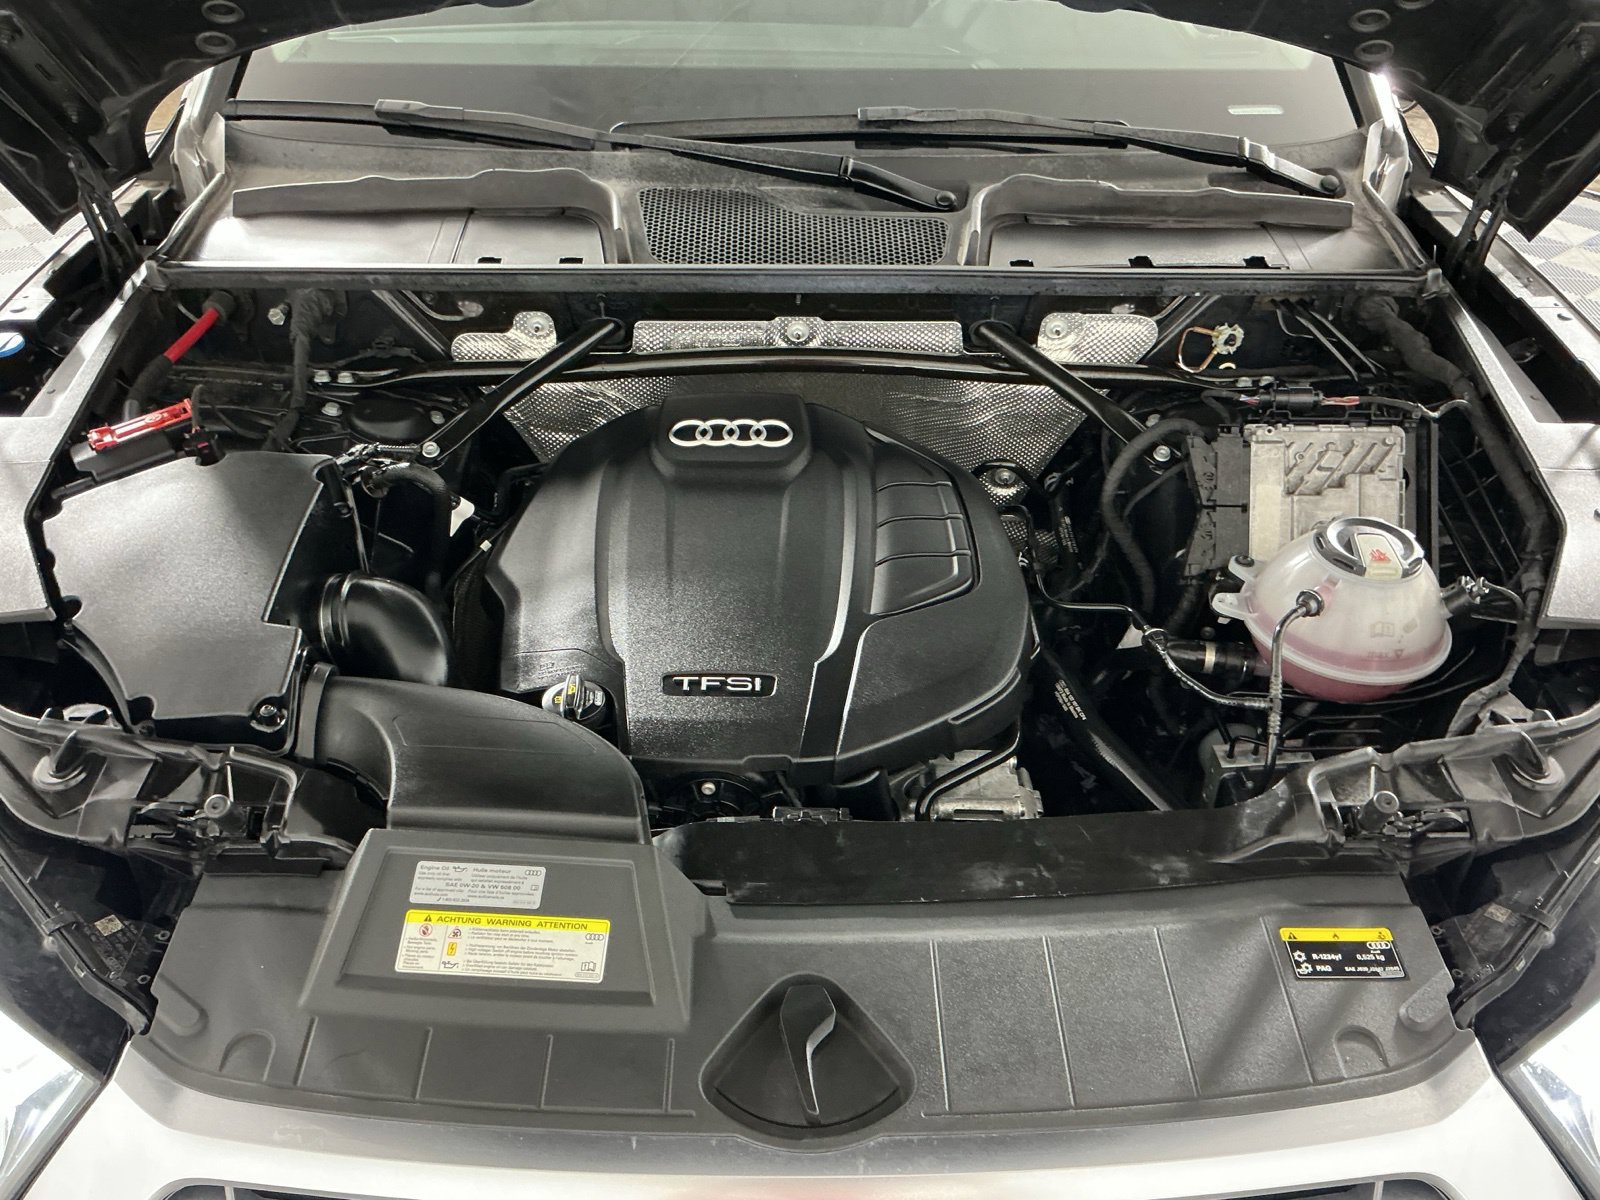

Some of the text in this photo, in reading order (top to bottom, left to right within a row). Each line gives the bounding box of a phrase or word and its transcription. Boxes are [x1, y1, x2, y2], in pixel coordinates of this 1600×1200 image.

[673, 676, 762, 692] TFSI
[436, 915, 482, 925] ACHTUNG
[486, 918, 533, 928] WARNING
[536, 920, 588, 931] ATTENTION
[1311, 953, 1342, 962] R-1234yf
[1375, 954, 1385, 962] kg
